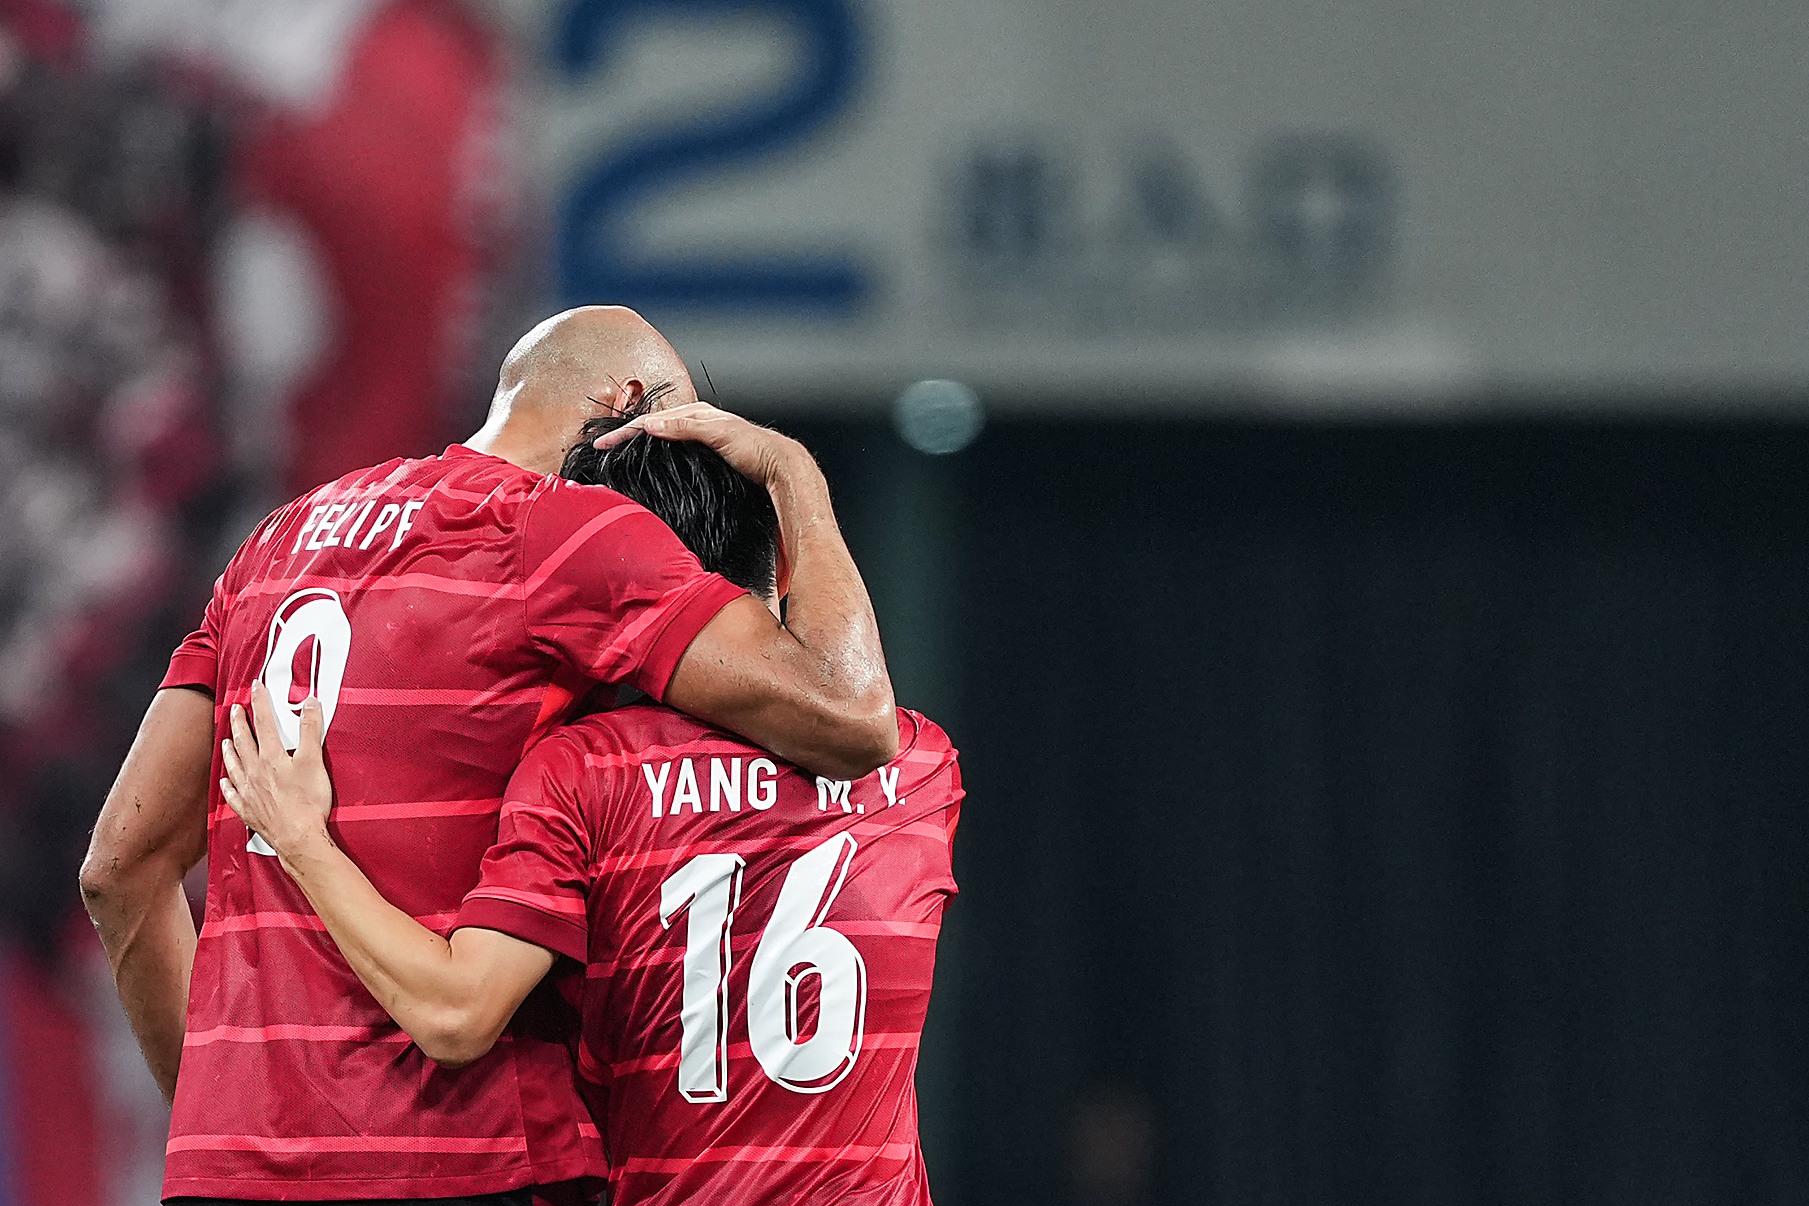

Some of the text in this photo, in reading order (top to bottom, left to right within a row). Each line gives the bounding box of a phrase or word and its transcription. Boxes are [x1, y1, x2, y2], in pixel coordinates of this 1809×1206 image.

[551, 0, 875, 318] 2
[642, 757, 778, 818] YANG
[659, 830, 868, 1104] 16
